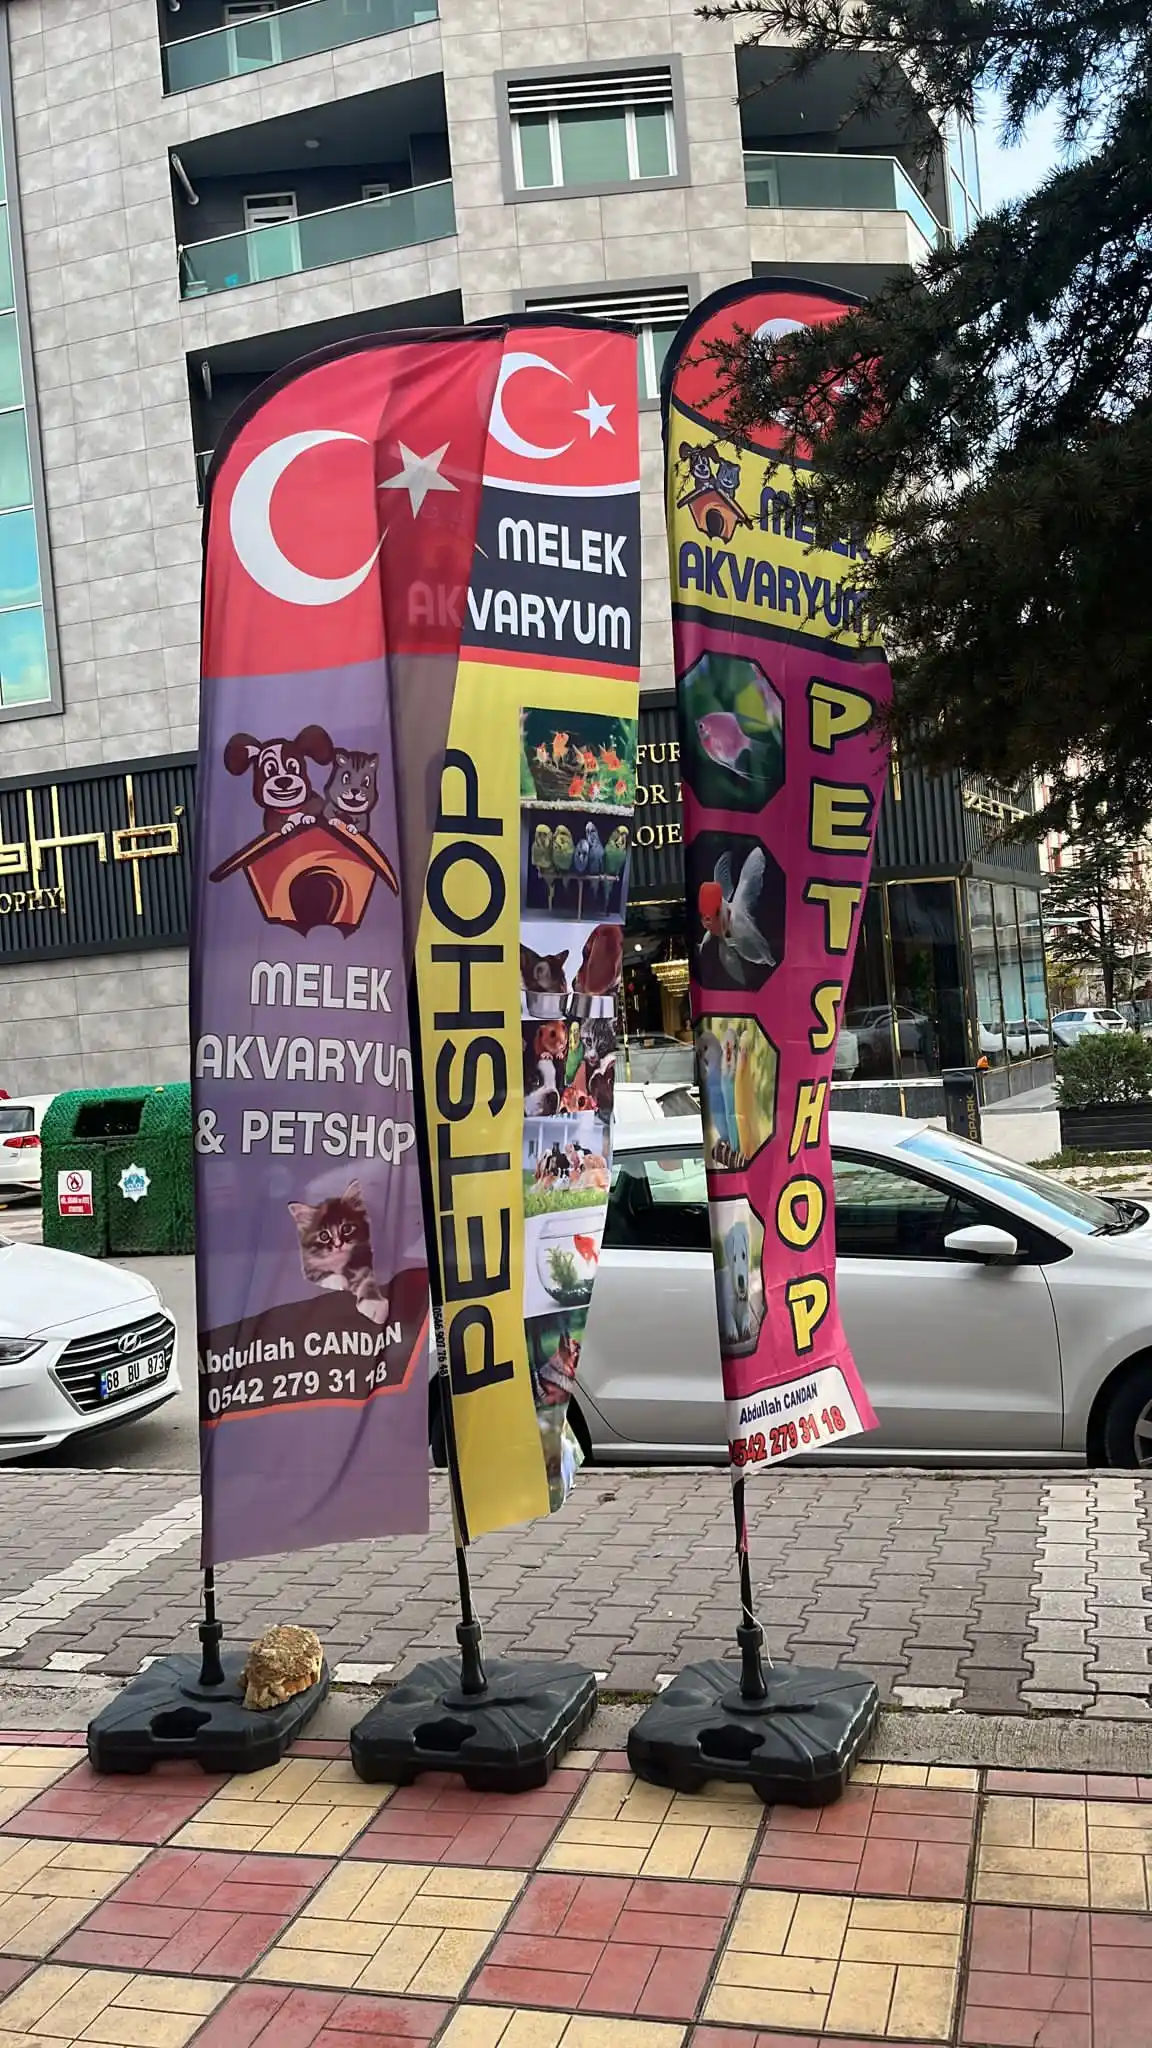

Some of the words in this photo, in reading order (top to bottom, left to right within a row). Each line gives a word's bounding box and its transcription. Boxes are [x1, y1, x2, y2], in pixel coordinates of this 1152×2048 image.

[498, 516, 628, 577] MELEK
[760, 487, 872, 562] MEK
[407, 580, 631, 650] AKVARYUM
[250, 960, 392, 1013] MELEK
[776, 676, 875, 1357] PETSHOP
[425, 748, 514, 1395] PETSHOP
[194, 1108, 225, 1154] &
[241, 1109, 416, 1165] PETSHOP
[304, 1322, 402, 1357] CANDAN
[106, 1370, 119, 1391] 68
[127, 1362, 140, 1383] BU
[147, 1353, 165, 1374] 873
[208, 1377, 264, 1414] 0542
[272, 1370, 319, 1400] 279
[328, 1369, 355, 1393] 31
[365, 1361, 387, 1390] 18
[739, 1397, 782, 1425] Abdullah
[783, 1382, 818, 1409] CANDAN
[769, 1421, 798, 1457] 279
[800, 1413, 820, 1444] 31
[821, 1405, 846, 1434] 18
